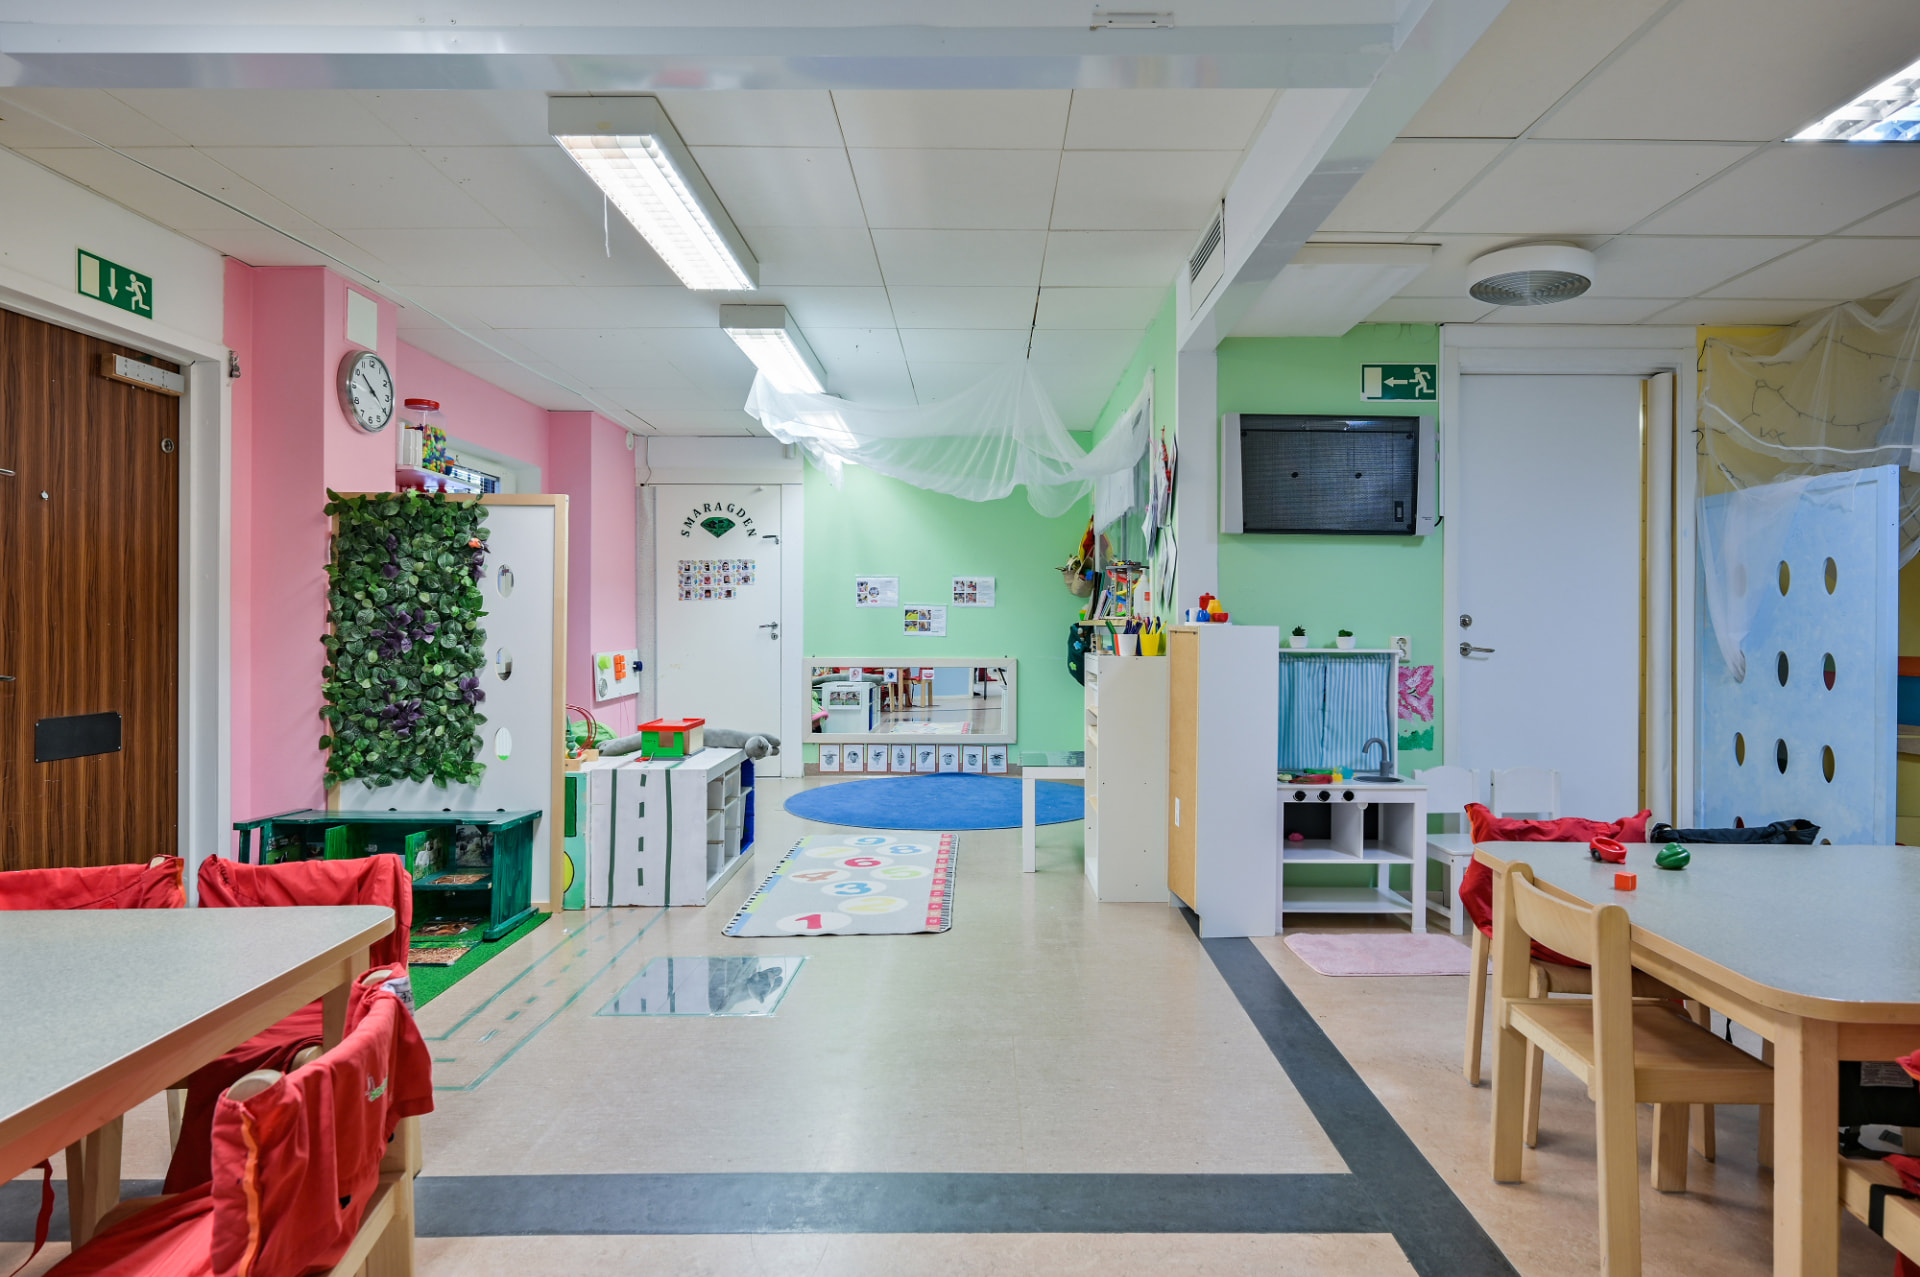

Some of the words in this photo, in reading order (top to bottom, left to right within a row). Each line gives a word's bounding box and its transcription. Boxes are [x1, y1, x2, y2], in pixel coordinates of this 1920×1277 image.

[369, 360, 375, 368] 12
[681, 502, 758, 538] SMARAGDEN
[856, 837, 886, 845] 9
[818, 848, 854, 857] 7
[890, 845, 922, 854] 8
[844, 857, 882, 867] 6
[792, 871, 838, 882] 4
[881, 866, 922, 878] 5
[834, 882, 872, 895] 3
[846, 897, 897, 912] 2
[794, 914, 822, 929] 1
